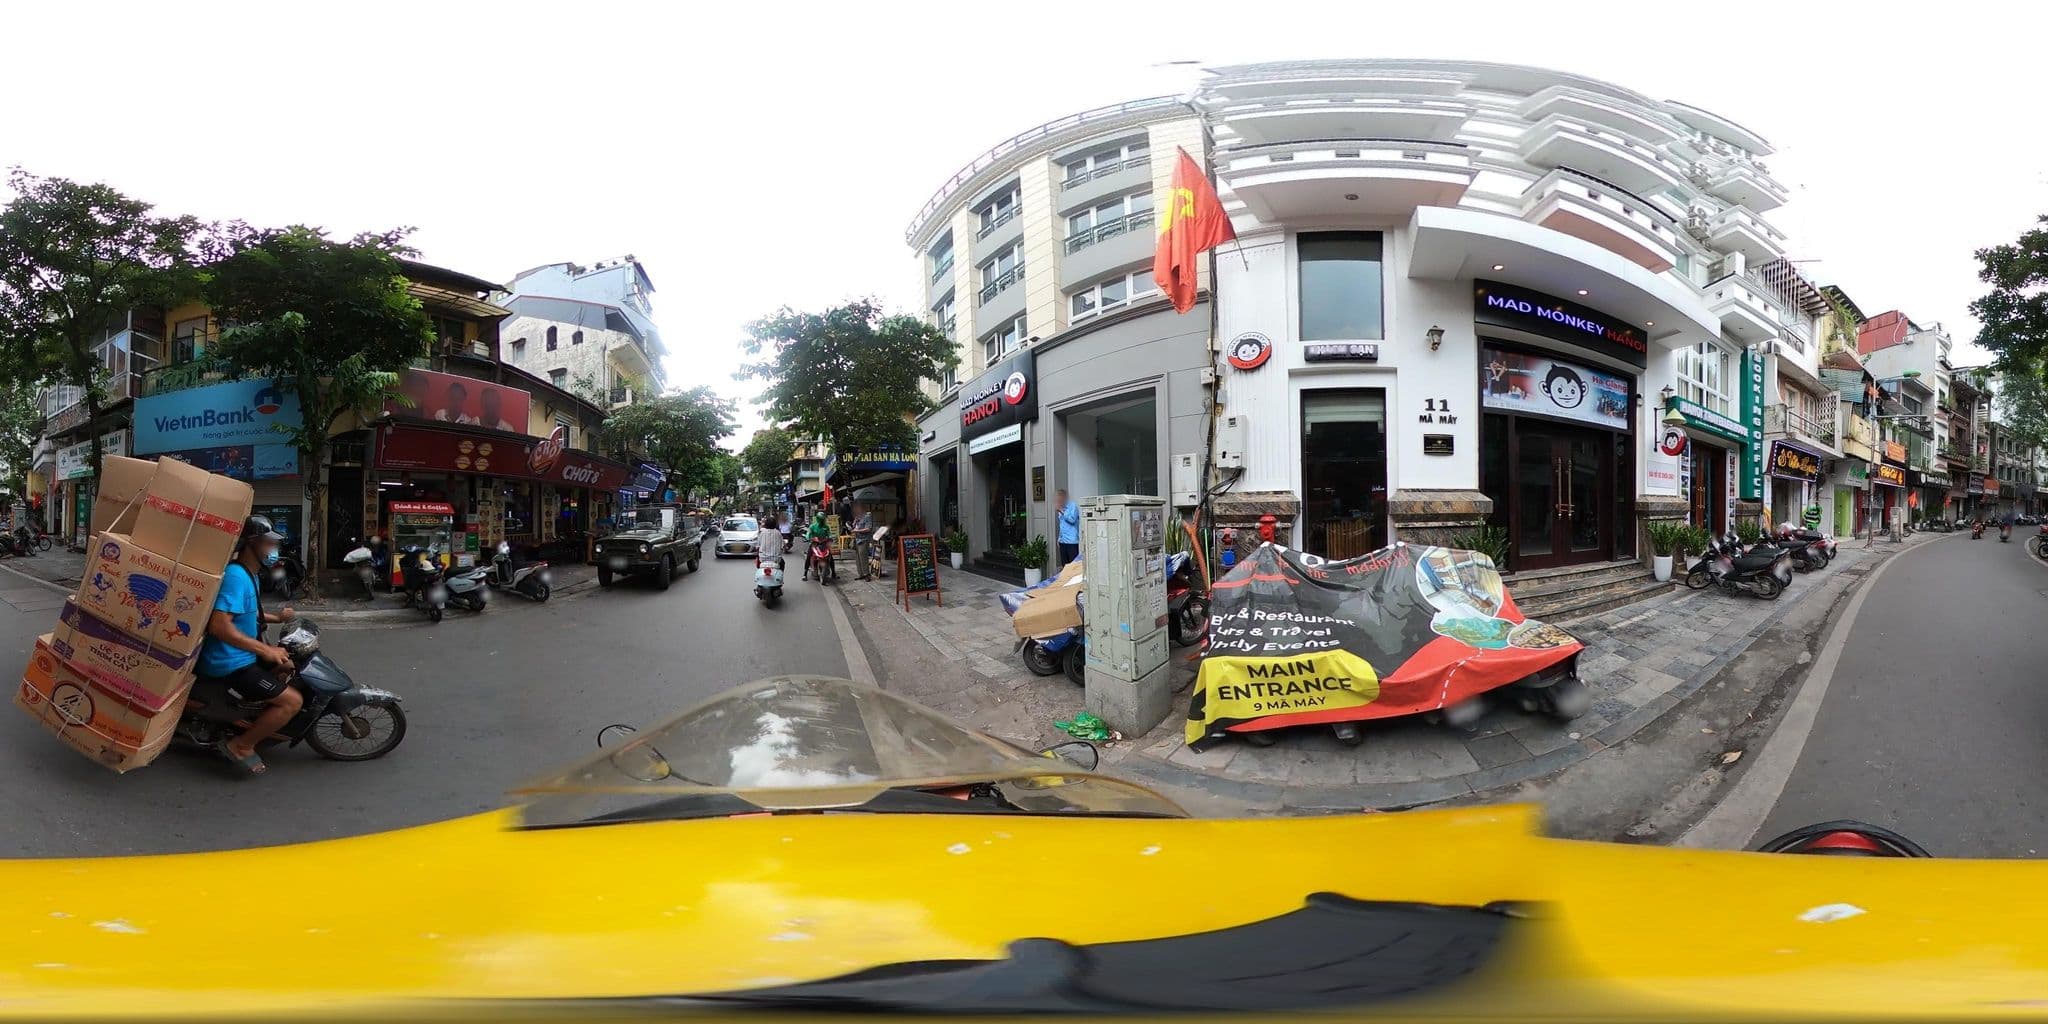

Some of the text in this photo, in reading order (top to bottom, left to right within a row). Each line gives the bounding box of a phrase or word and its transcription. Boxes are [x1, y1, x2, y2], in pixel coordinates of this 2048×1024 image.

[1488, 295, 1646, 353] MAD MONKEY HANOI
[960, 380, 1003, 409] MAD MONKEY
[963, 398, 999, 425] HANOI
[1425, 398, 1450, 412] 11
[154, 405, 256, 433] VietinBank
[1753, 353, 1761, 498] BOOKING OFFICE
[176, 573, 206, 590] FOODS
[1306, 566, 1330, 579] the
[1211, 607, 1356, 627] Br & Restaurant
[1249, 628, 1263, 636] &
[1270, 627, 1332, 637] Travel
[1263, 639, 1341, 651] Events
[1247, 660, 1315, 679] MAIN
[1218, 677, 1352, 700] ENTRANCE
[1254, 702, 1263, 711] 9
